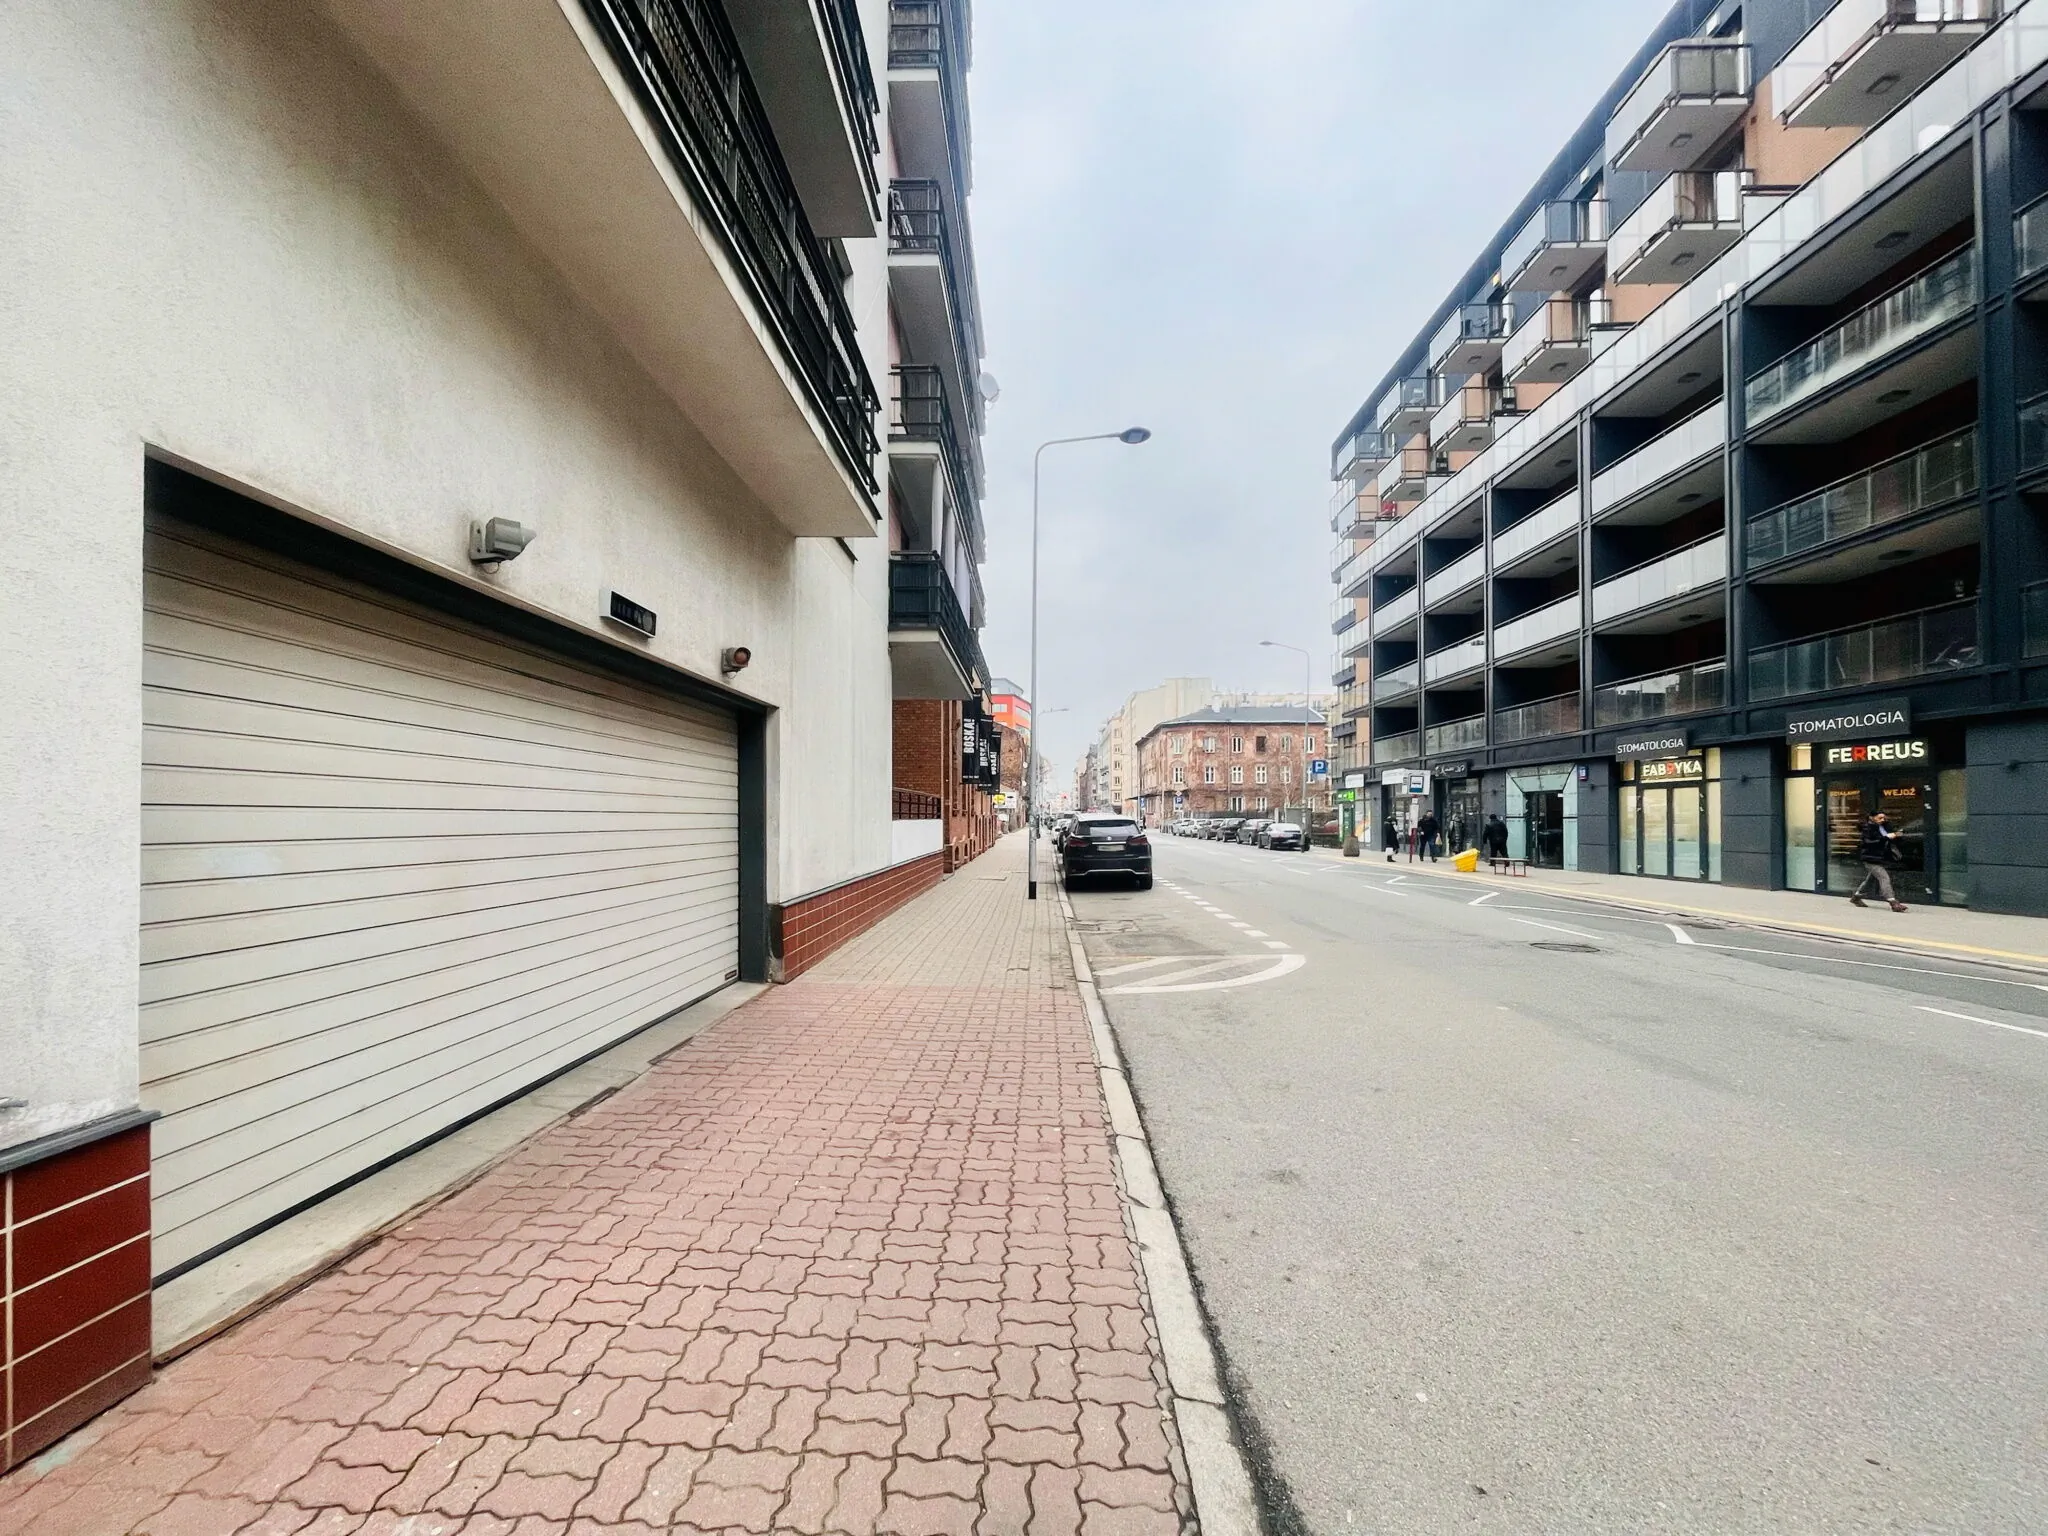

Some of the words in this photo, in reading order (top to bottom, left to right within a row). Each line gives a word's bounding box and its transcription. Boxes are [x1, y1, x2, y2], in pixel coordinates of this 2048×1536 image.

[1789, 710, 1904, 734] STOMATOLOGIA
[963, 718, 975, 754] BOSKA!
[1617, 737, 1684, 754] STOMATOLOGIA
[1828, 741, 1925, 763] FERREUS
[1314, 761, 1325, 773] P
[1643, 760, 1702, 776] FABRYKA
[1883, 787, 1916, 796] WEJDŹ
